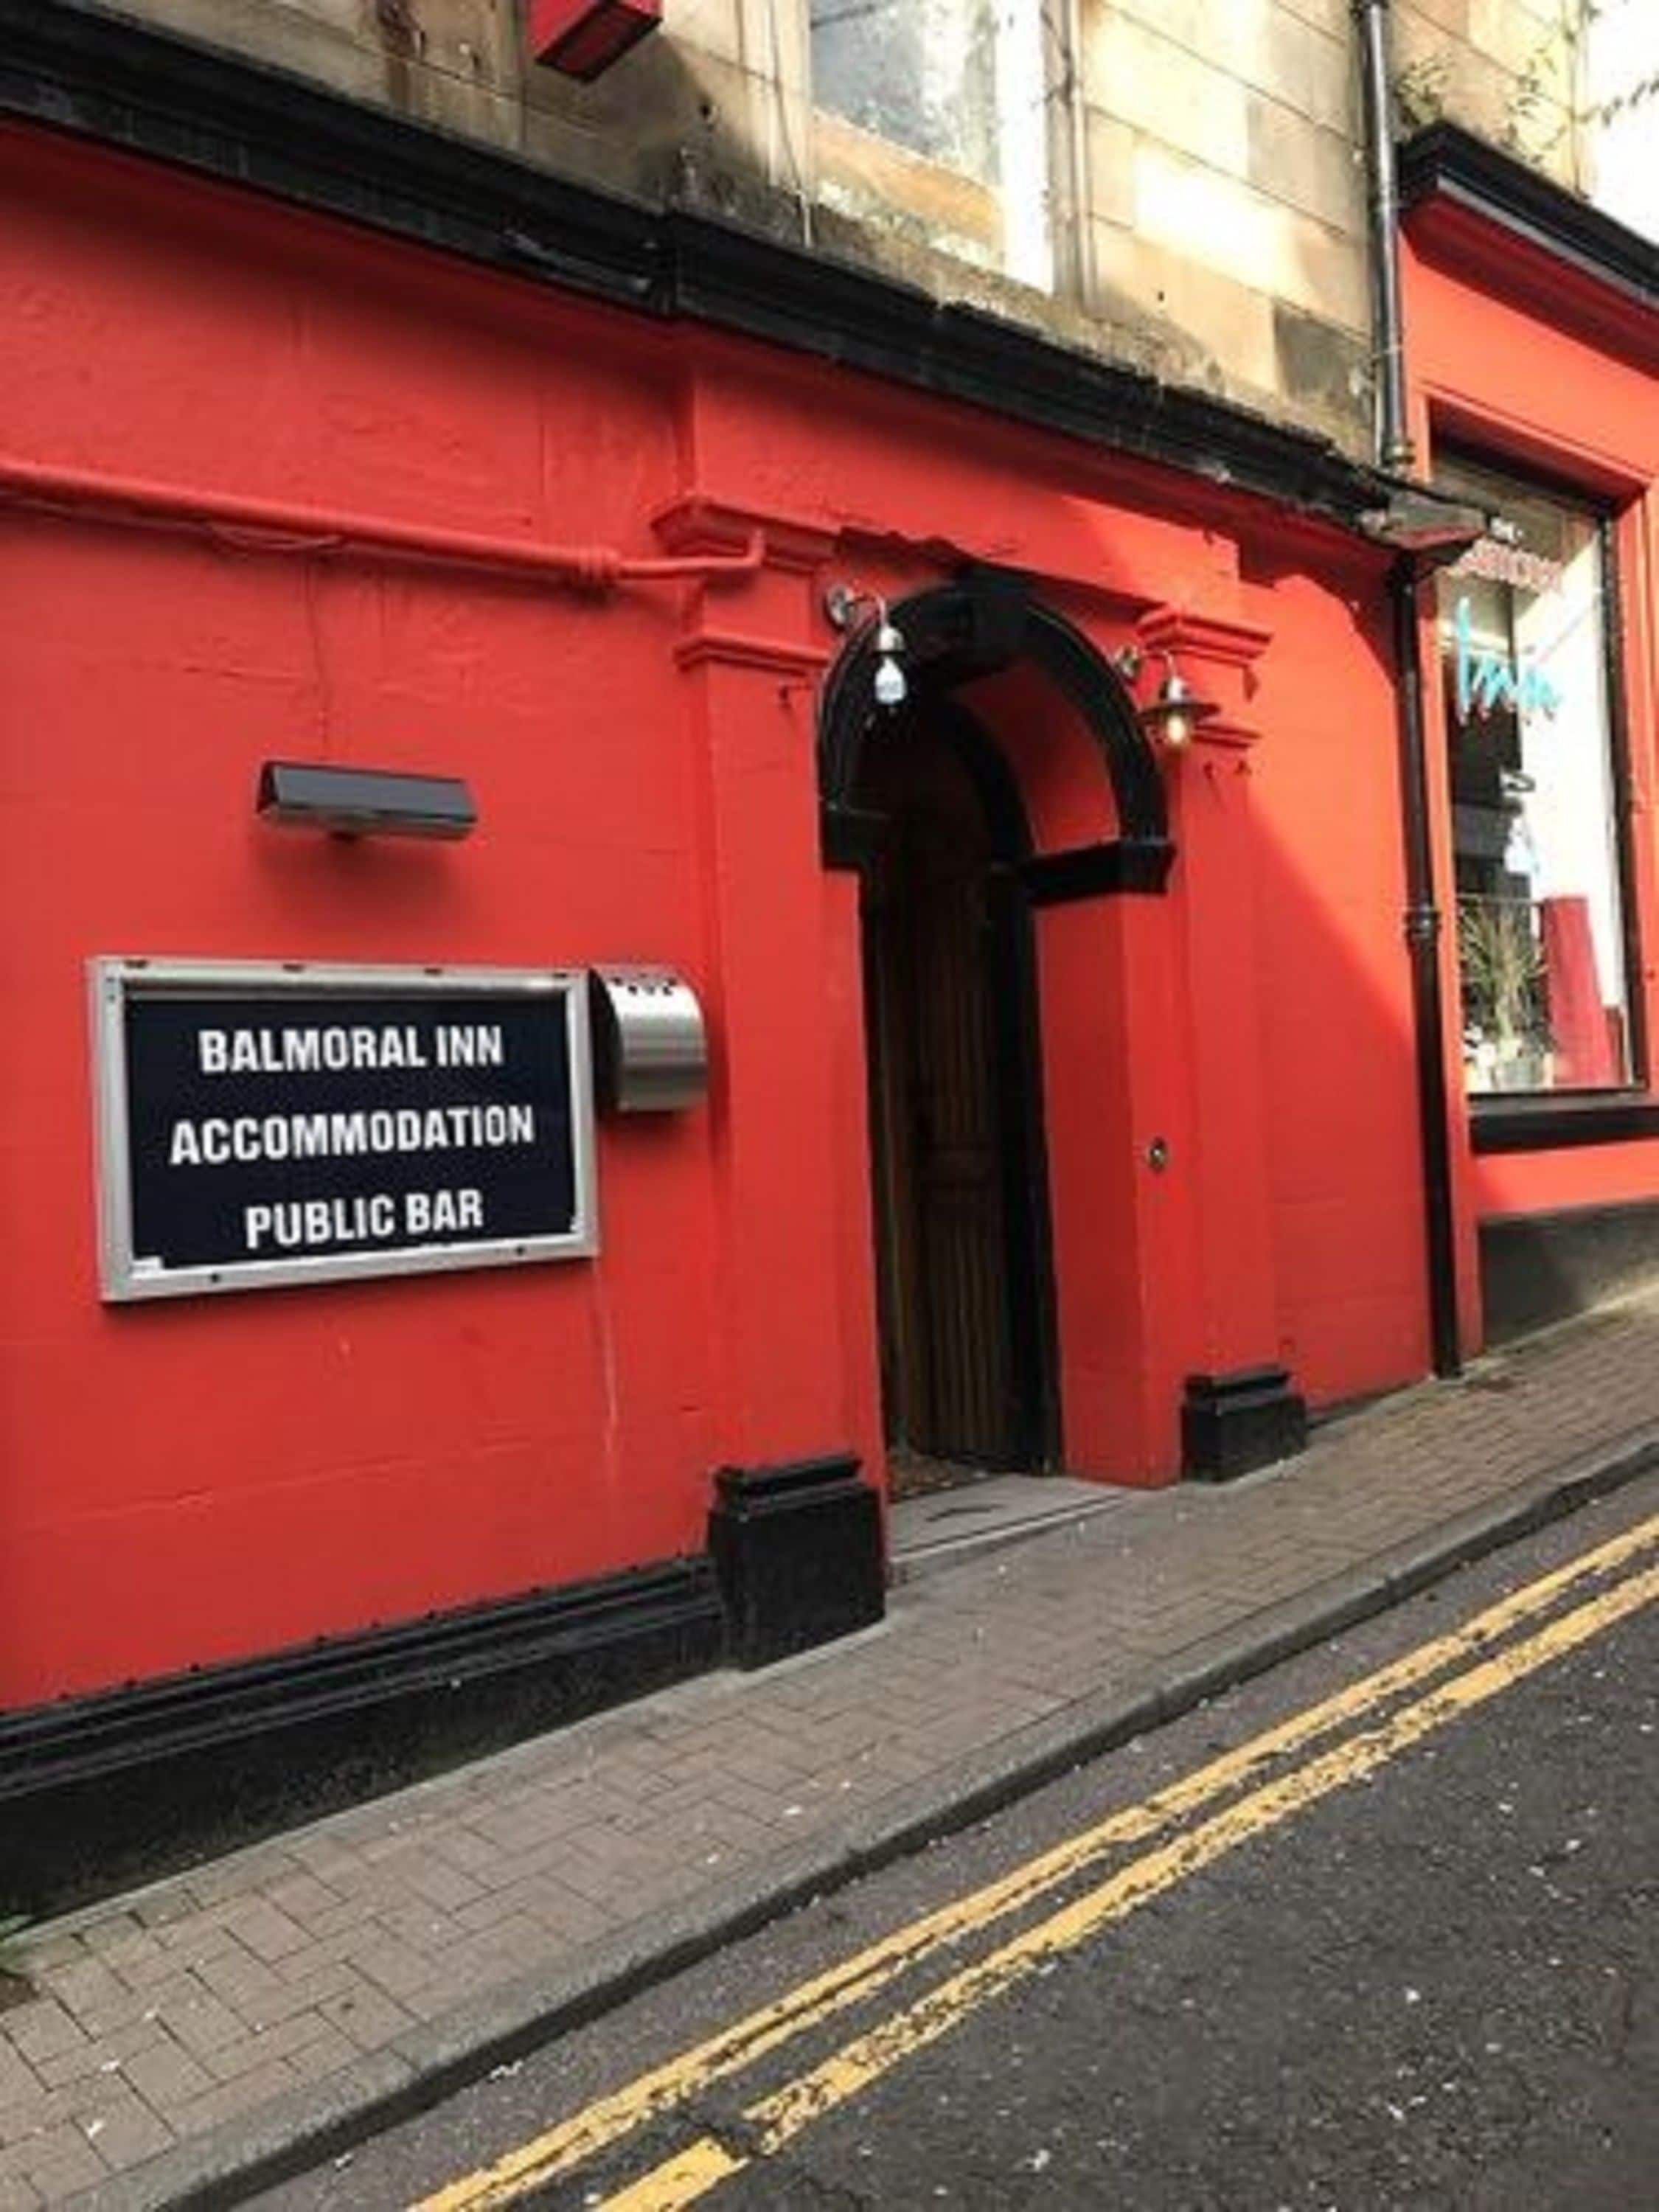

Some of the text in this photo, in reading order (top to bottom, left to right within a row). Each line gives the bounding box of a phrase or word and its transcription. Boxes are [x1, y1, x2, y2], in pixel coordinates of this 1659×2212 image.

[198, 1025, 503, 1074] BALMORAL INN
[170, 1105, 535, 1165] ACCOMMODATION
[245, 1189, 484, 1249] PUBLIC BAR
